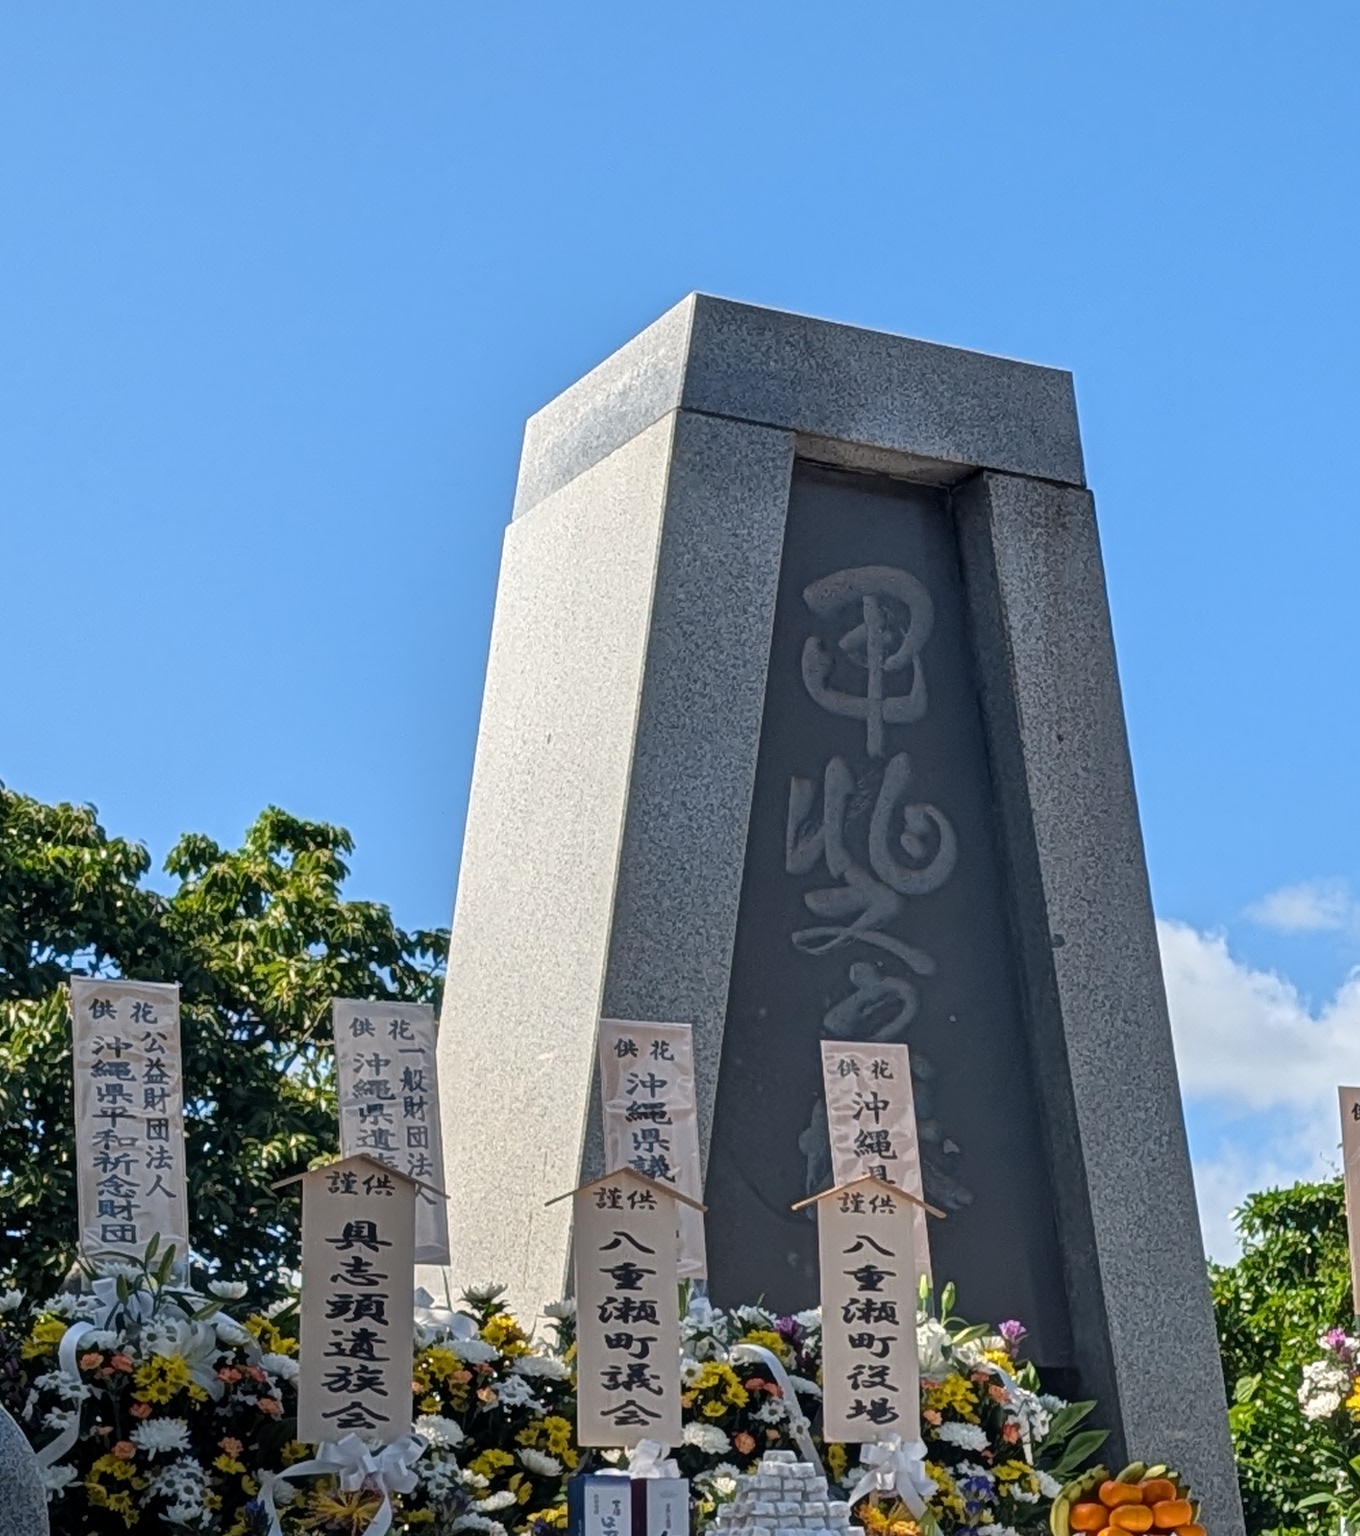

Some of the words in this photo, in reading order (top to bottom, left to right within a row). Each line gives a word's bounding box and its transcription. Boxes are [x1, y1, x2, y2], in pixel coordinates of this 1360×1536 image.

[88, 998, 159, 1026] 供花
[348, 1017, 415, 1042] 供花
[613, 1037, 675, 1062] 供花
[837, 1059, 894, 1080] 供花
[141, 1031, 177, 1199] 公益財団法人
[90, 1035, 141, 1245] 沖縄県平和祈念財団
[325, 1170, 396, 1197] 謹供
[593, 1187, 658, 1211] 謹供
[837, 1192, 897, 1215] 謹供
[321, 1219, 394, 1430] 具志頭遺族会
[597, 1230, 664, 1428] 八重瀬町議会
[840, 1232, 901, 1427] 八重瀬町役場
